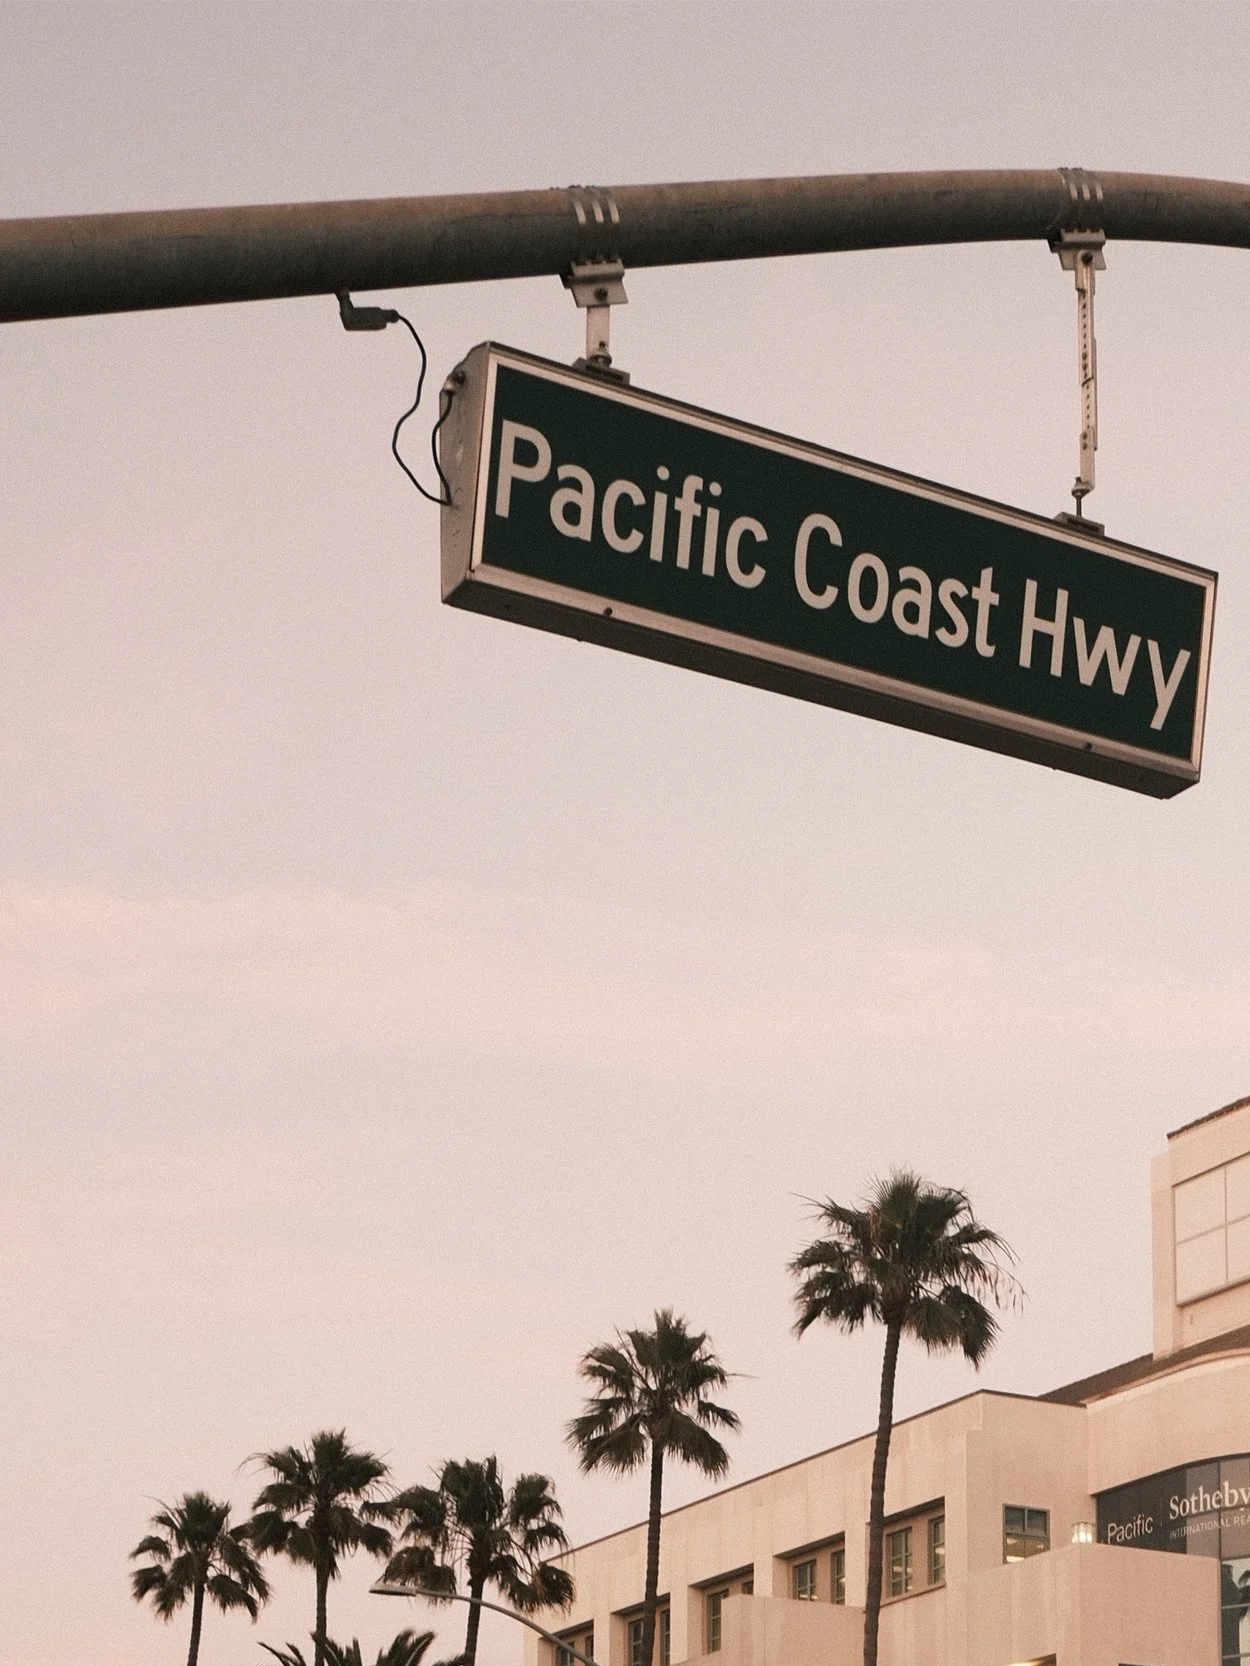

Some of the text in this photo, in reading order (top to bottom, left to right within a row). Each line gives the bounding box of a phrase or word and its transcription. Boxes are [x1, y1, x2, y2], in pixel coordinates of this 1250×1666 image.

[495, 419, 1192, 732] Pacific Coast Hwy
[1107, 1513, 1154, 1544] Pacific
